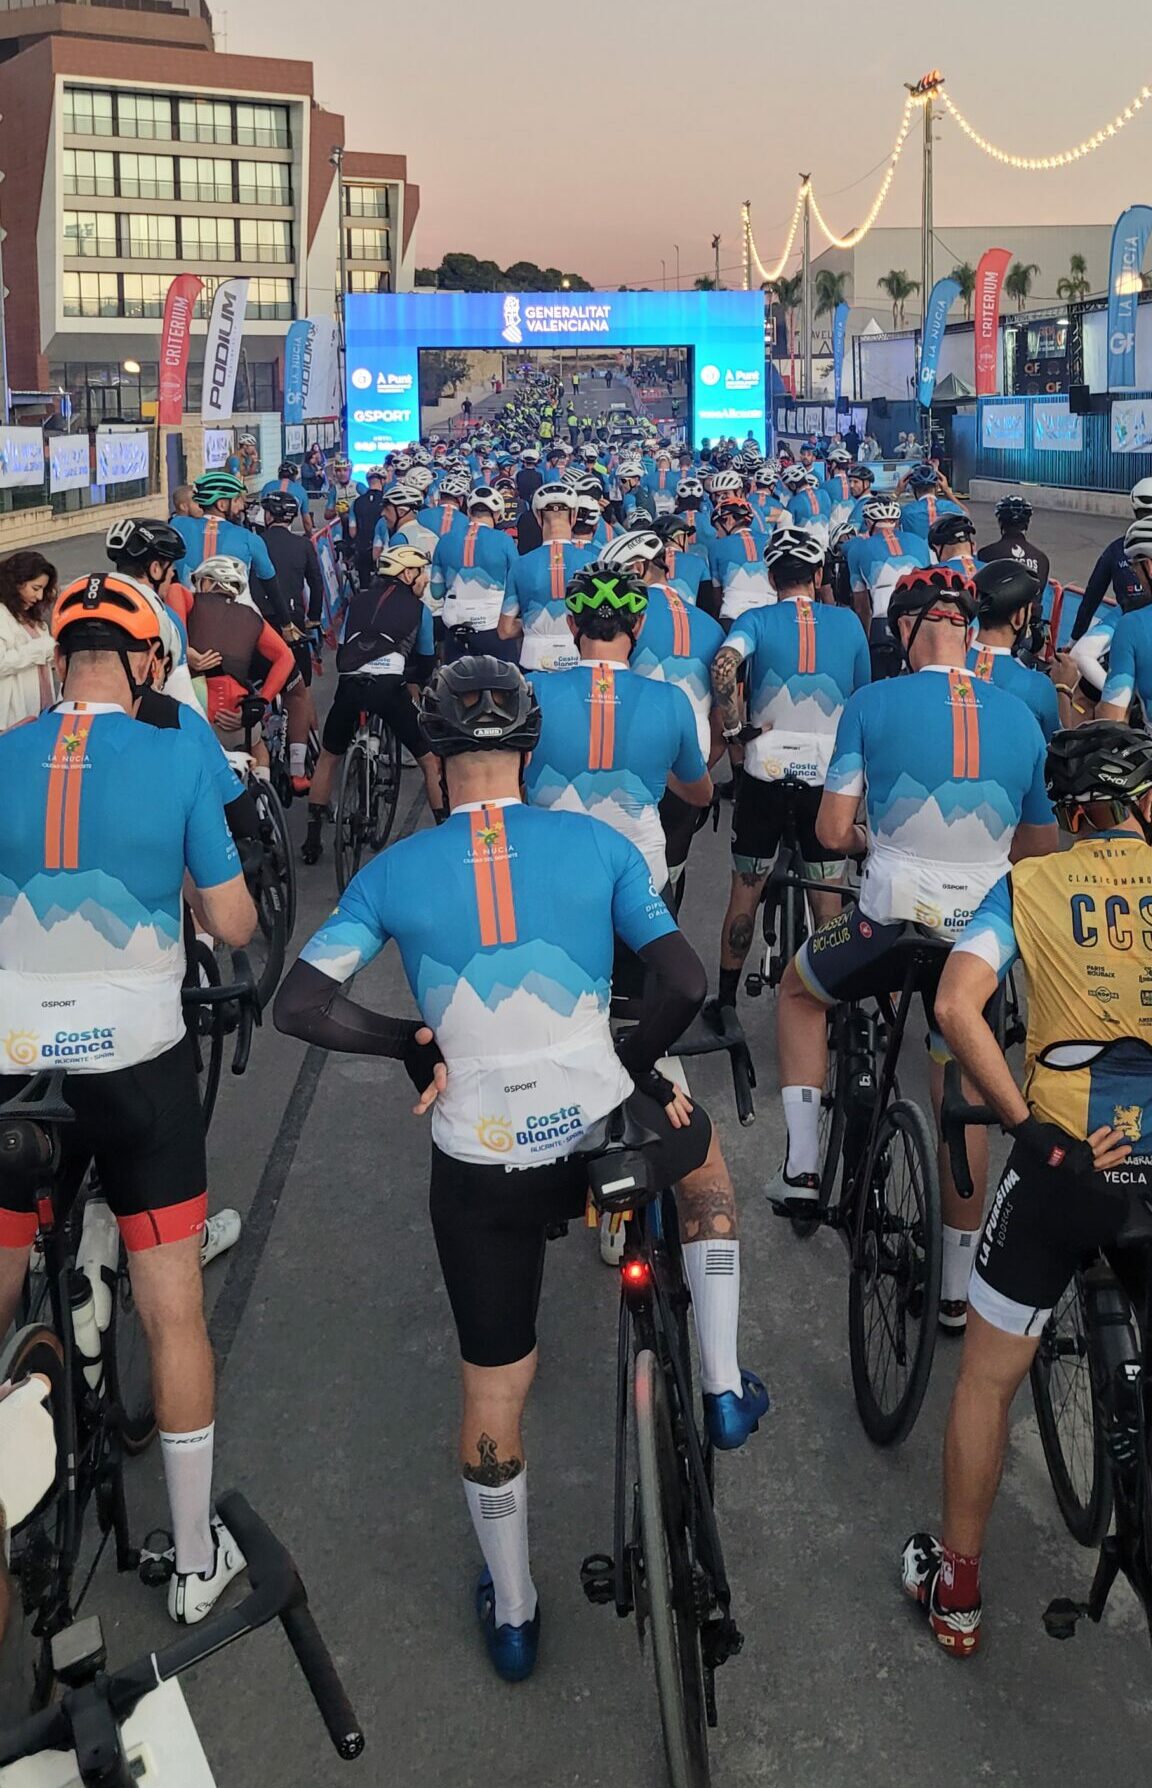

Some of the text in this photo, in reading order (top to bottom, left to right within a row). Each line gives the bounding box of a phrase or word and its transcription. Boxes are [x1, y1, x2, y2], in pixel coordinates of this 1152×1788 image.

[525, 305, 612, 319] GENERALITAT
[982, 271, 999, 338] CRITERIUM
[1118, 300, 1132, 317] LA
[165, 295, 189, 366] CRITERIUM
[526, 319, 609, 332] VALENCIANA
[209, 290, 237, 409] PODIUM
[353, 409, 411, 422] GSPORT
[88, 579, 100, 599] POC
[790, 762, 817, 770] Costa
[953, 908, 976, 918] Cos
[41, 1000, 77, 1008] GSPORT
[55, 1027, 114, 1044] Costa
[41, 1040, 114, 1058] Blanca
[54, 1056, 89, 1065] ALICANTE
[504, 1081, 537, 1093] GSPORT
[526, 1105, 580, 1129] Costa
[516, 1118, 582, 1145] Blanca
[1103, 1171, 1147, 1184] YECLA
[996, 1201, 1014, 1248] BODEGAS
[979, 1241, 991, 1267] LA
